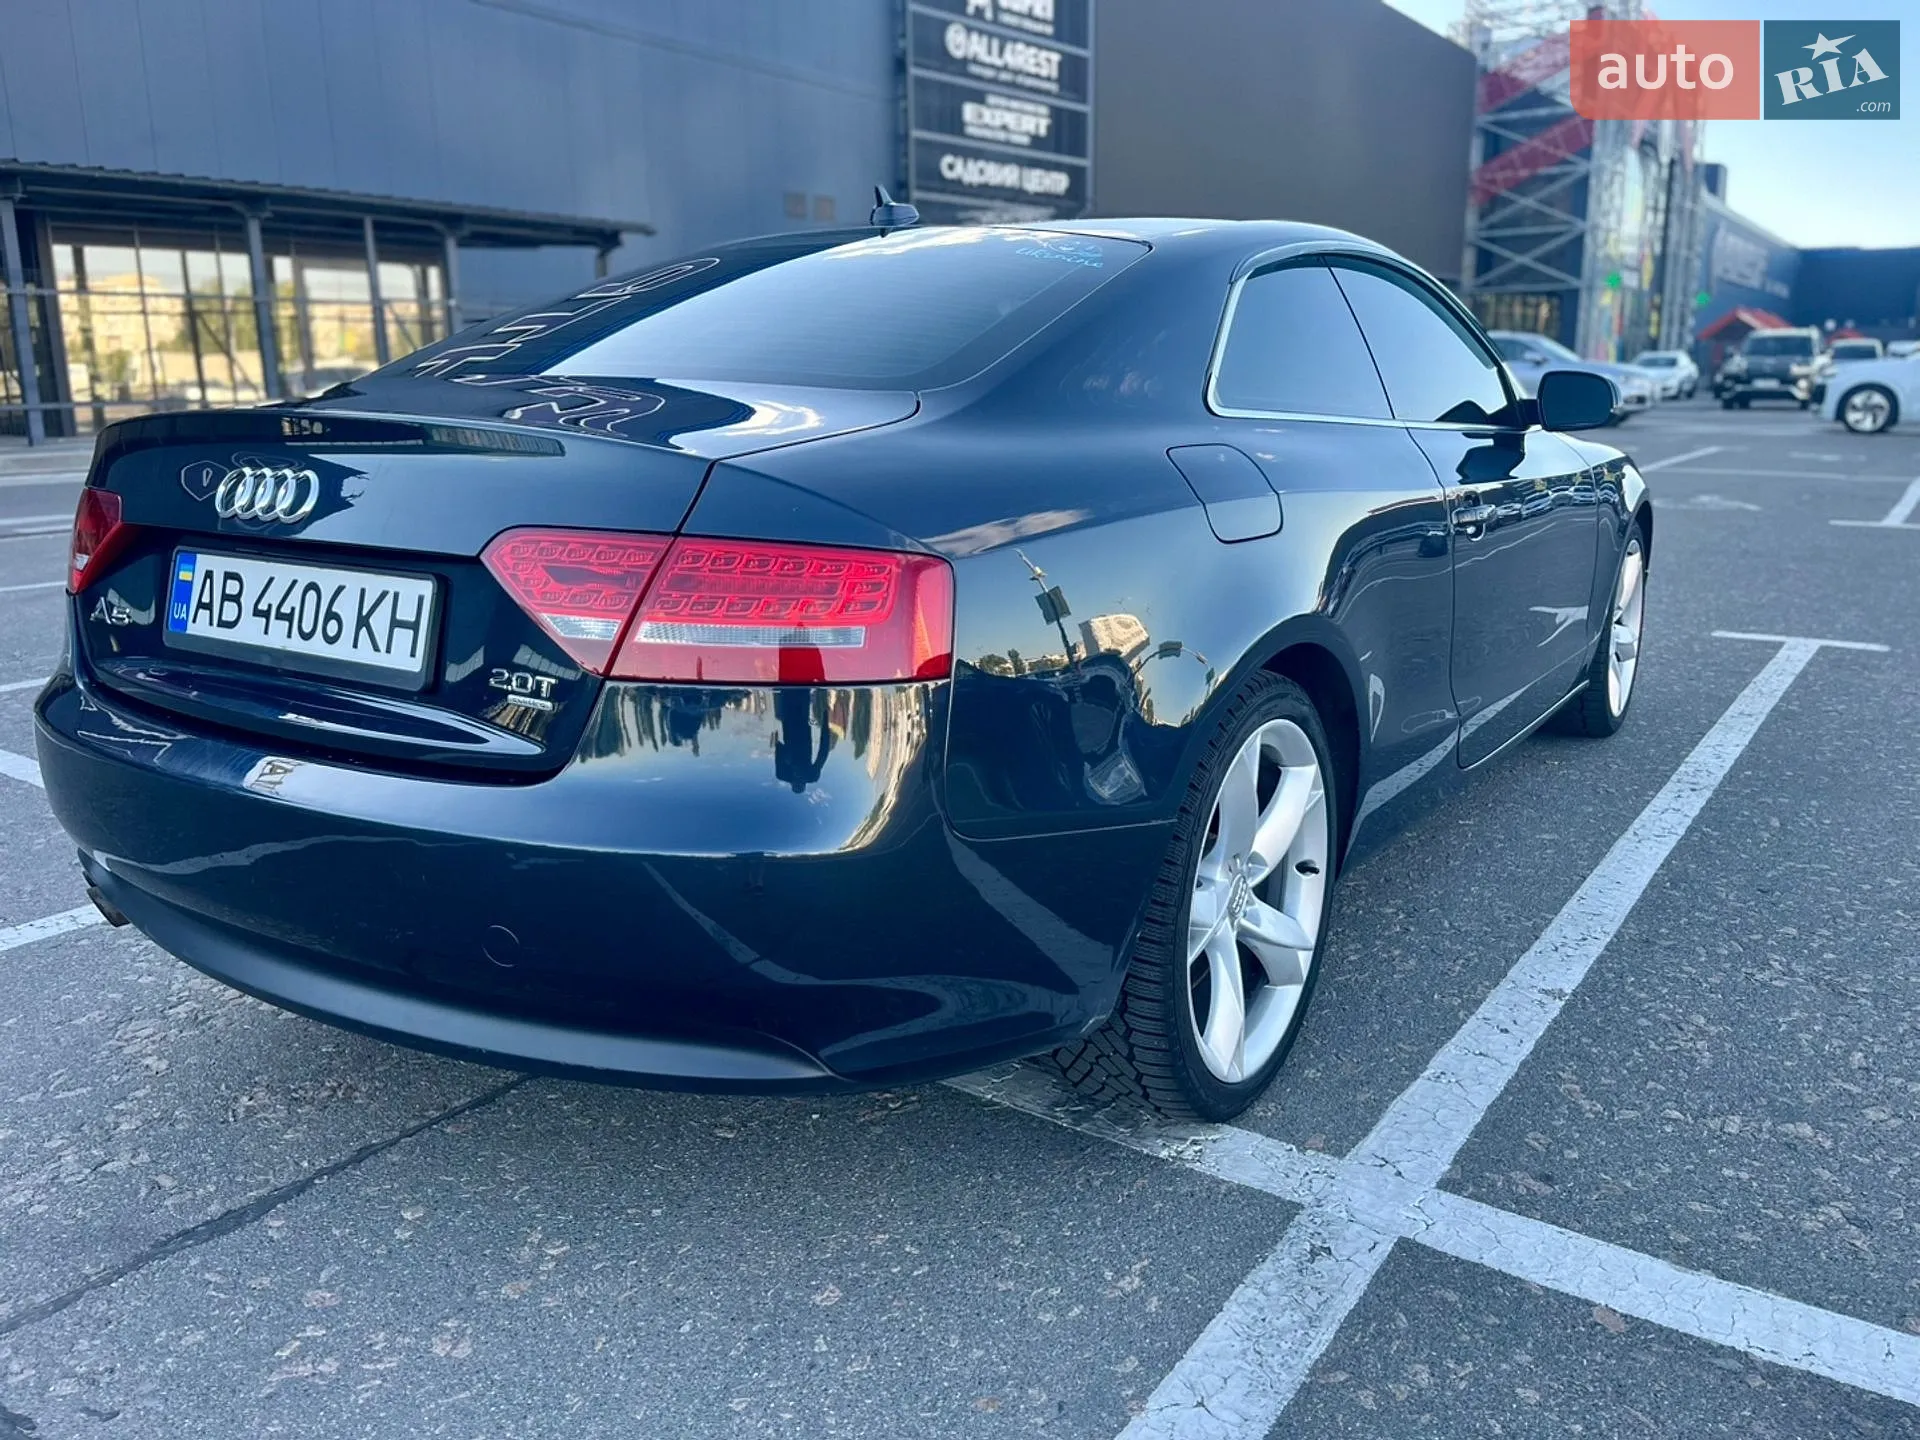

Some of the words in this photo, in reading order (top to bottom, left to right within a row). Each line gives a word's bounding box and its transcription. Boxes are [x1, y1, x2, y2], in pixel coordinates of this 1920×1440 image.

[1021, 167, 1070, 195] ЦЕНТР
[173, 602, 187, 621] UA
[191, 569, 245, 630] AB
[252, 576, 347, 646] 4406
[352, 587, 426, 658] KH
[489, 668, 559, 699] 2.0T
